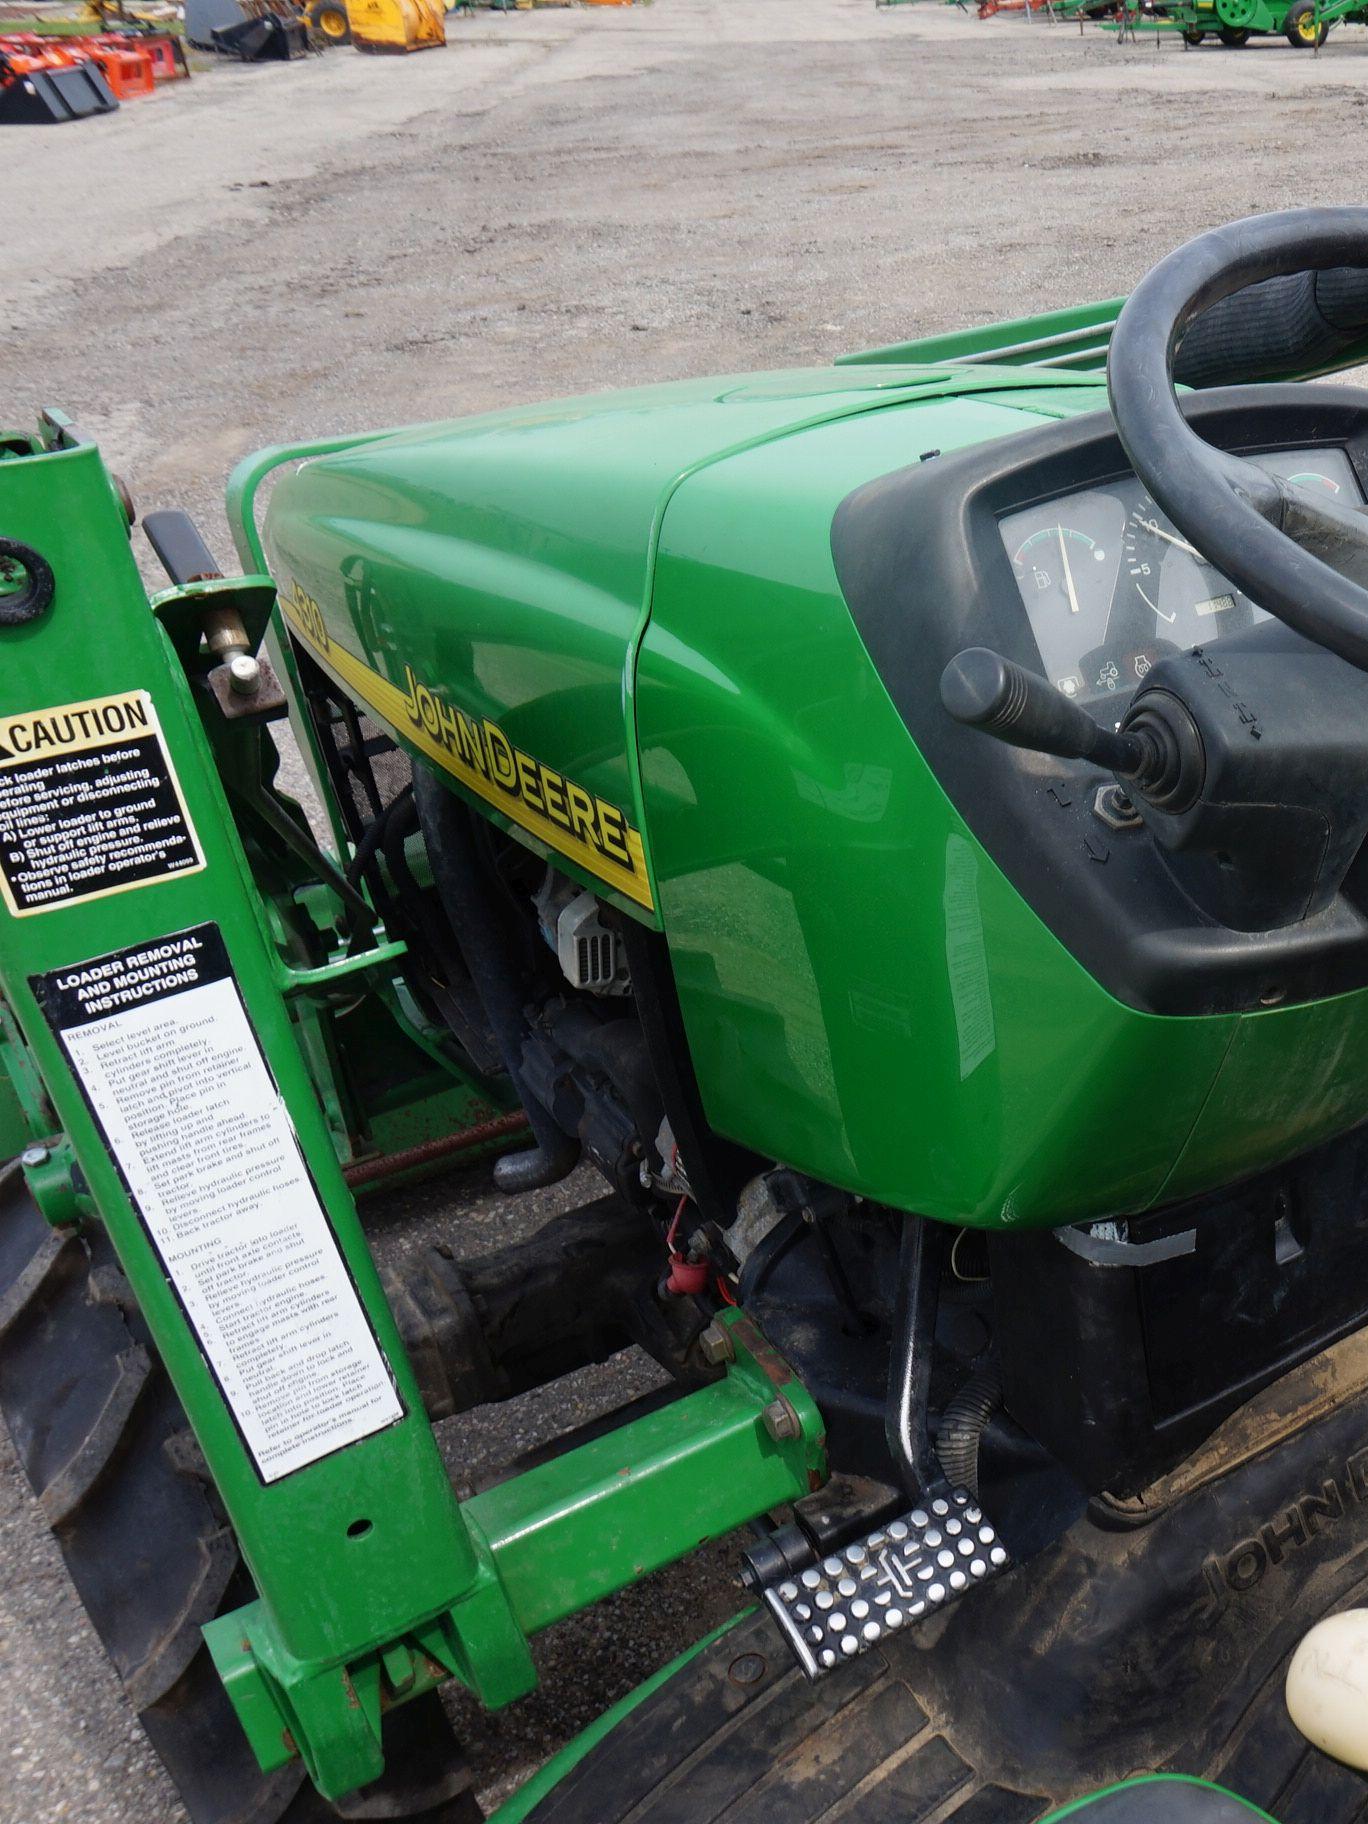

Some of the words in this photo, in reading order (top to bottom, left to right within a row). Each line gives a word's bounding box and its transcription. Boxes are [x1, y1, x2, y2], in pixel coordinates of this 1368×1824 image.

[8, 699, 148, 754] CAUTION
[14, 767, 54, 783] loader
[55, 757, 100, 774] latches
[101, 749, 140, 764] before
[0, 795, 31, 809] efore
[33, 782, 93, 802] servicing,
[95, 769, 150, 788] adjusting
[61, 796, 74, 806] or
[77, 777, 160, 803] disconnecting
[0, 820, 14, 832] oil
[15, 814, 50, 828] lines:
[3, 830, 17, 842] A)
[18, 823, 56, 839] Lower
[58, 813, 96, 829] loader
[98, 810, 112, 820] to
[113, 798, 156, 818] ground
[9, 851, 25, 863] B)
[26, 844, 56, 859] Shut
[58, 839, 74, 852] off
[76, 830, 117, 847] engine
[119, 823, 141, 837] and
[143, 815, 181, 831] relieve
[23, 838, 36, 851] or
[39, 826, 87, 845] support
[87, 821, 104, 834] lift
[106, 815, 139, 829] arms.
[17, 864, 69, 882] Observe
[71, 854, 106, 870] safety
[109, 835, 186, 860] recommenda-
[21, 879, 53, 893] tions
[54, 875, 68, 885] in
[68, 865, 105, 881] loader
[108, 850, 166, 871] operator's
[30, 848, 87, 869] hydraulic
[88, 836, 144, 856] pressure.
[25, 884, 74, 902] manual.
[56, 961, 124, 990] LOADER
[126, 937, 203, 969] REMOVAL
[78, 981, 111, 1001] AND
[113, 954, 196, 989] MOUNTING
[85, 968, 198, 1014] INSTRUCTIONS
[67, 1020, 122, 1041] REMOVAL
[168, 1238, 222, 1263] MOUNTING
